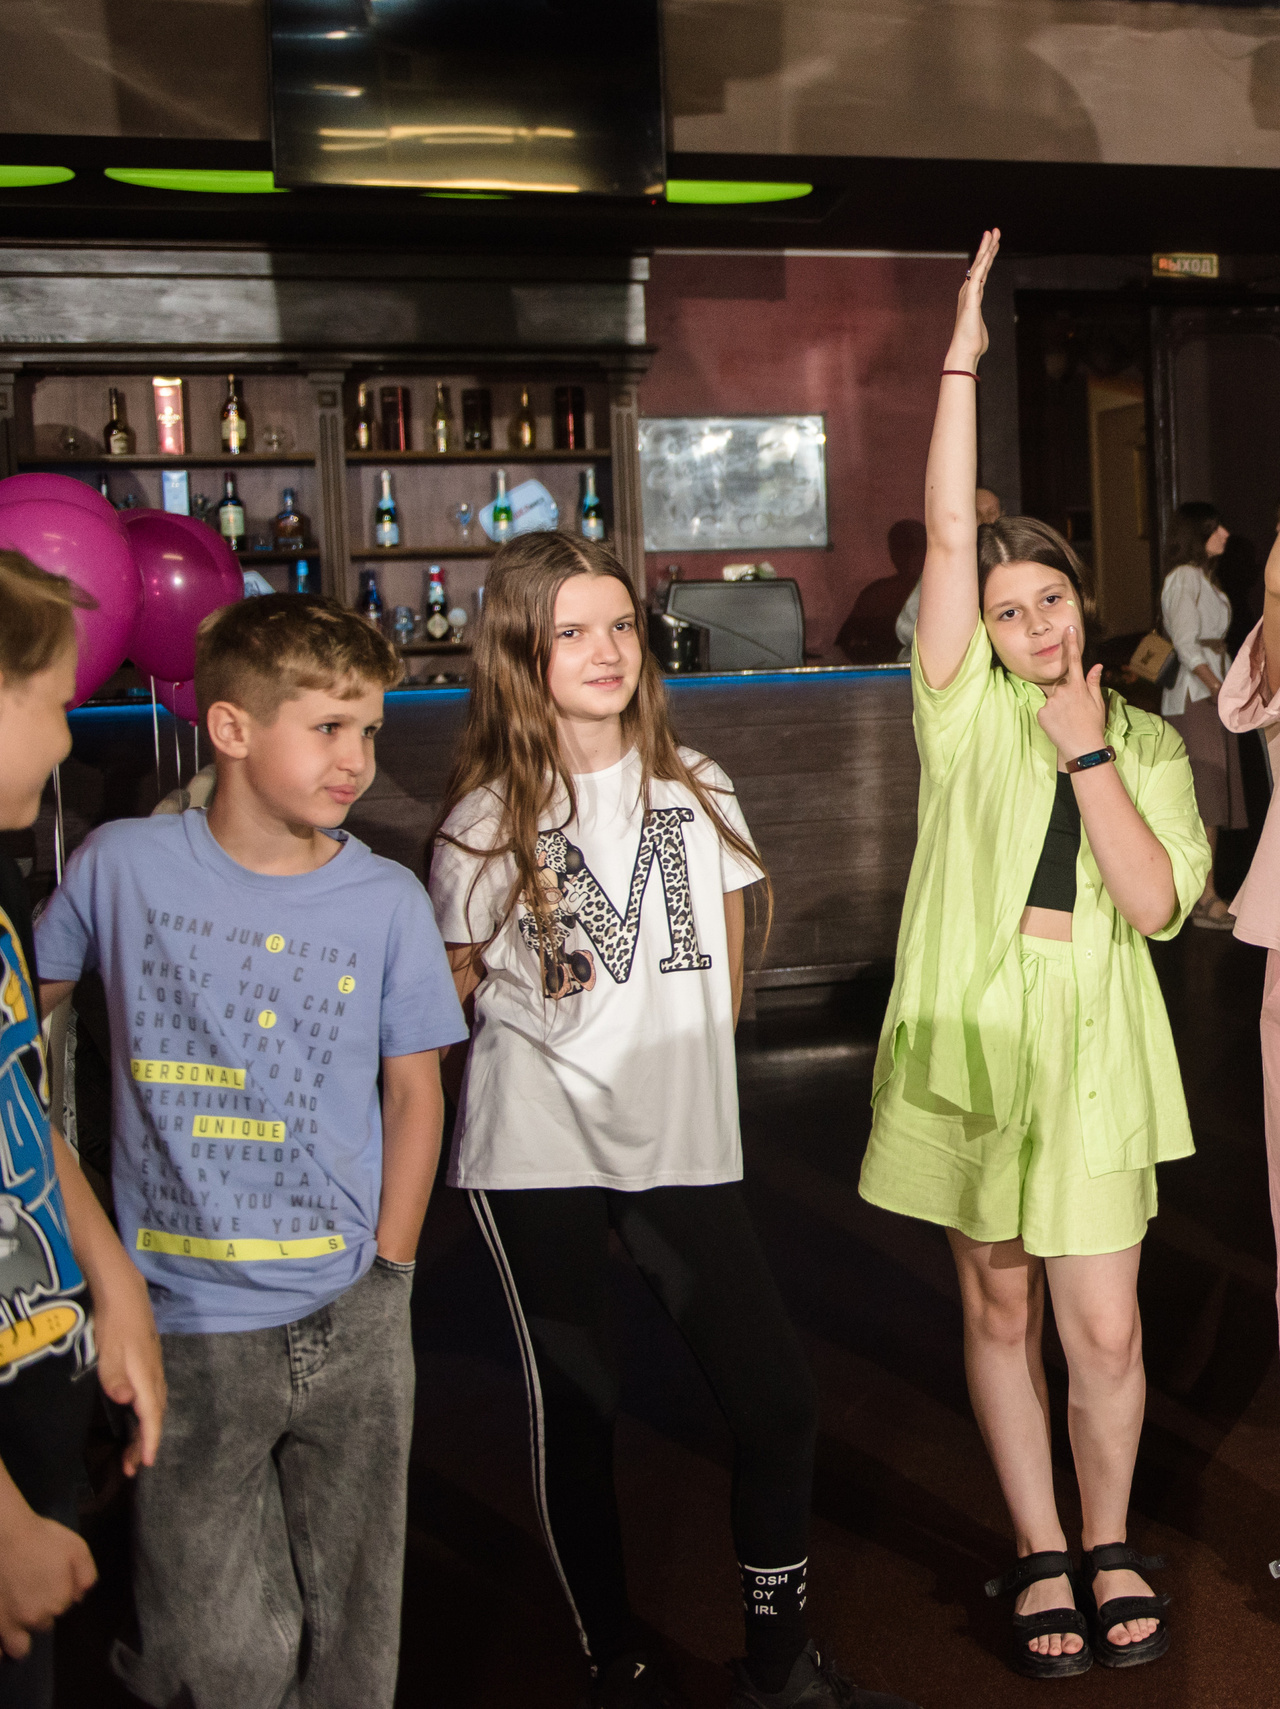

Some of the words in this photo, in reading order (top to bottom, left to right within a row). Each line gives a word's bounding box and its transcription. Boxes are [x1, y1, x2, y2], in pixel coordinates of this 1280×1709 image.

[1158, 257, 1212, 274] ВЫХОД
[535, 806, 712, 999] M
[146, 907, 214, 938] URBAN
[225, 926, 311, 959] JUNGLE
[320, 946, 339, 963] IS
[346, 952, 358, 969] A
[142, 959, 212, 988] WHERE
[239, 980, 280, 1002] YOU
[303, 994, 346, 1017] CAN
[138, 986, 200, 1008] LOST
[224, 1003, 275, 1029] BUT
[293, 1016, 340, 1042] YOU
[133, 1036, 219, 1059] KEEP
[245, 1060, 325, 1089] YOUR
[242, 1032, 286, 1055] TRY
[306, 1047, 333, 1065] TO
[284, 1091, 318, 1112] AND
[198, 1118, 282, 1139] UNIQUE
[234, 1193, 272, 1211] YOU
[290, 1193, 338, 1211] WILL
[272, 1215, 335, 1235] YOUR
[142, 1232, 338, 1258] GOALS
